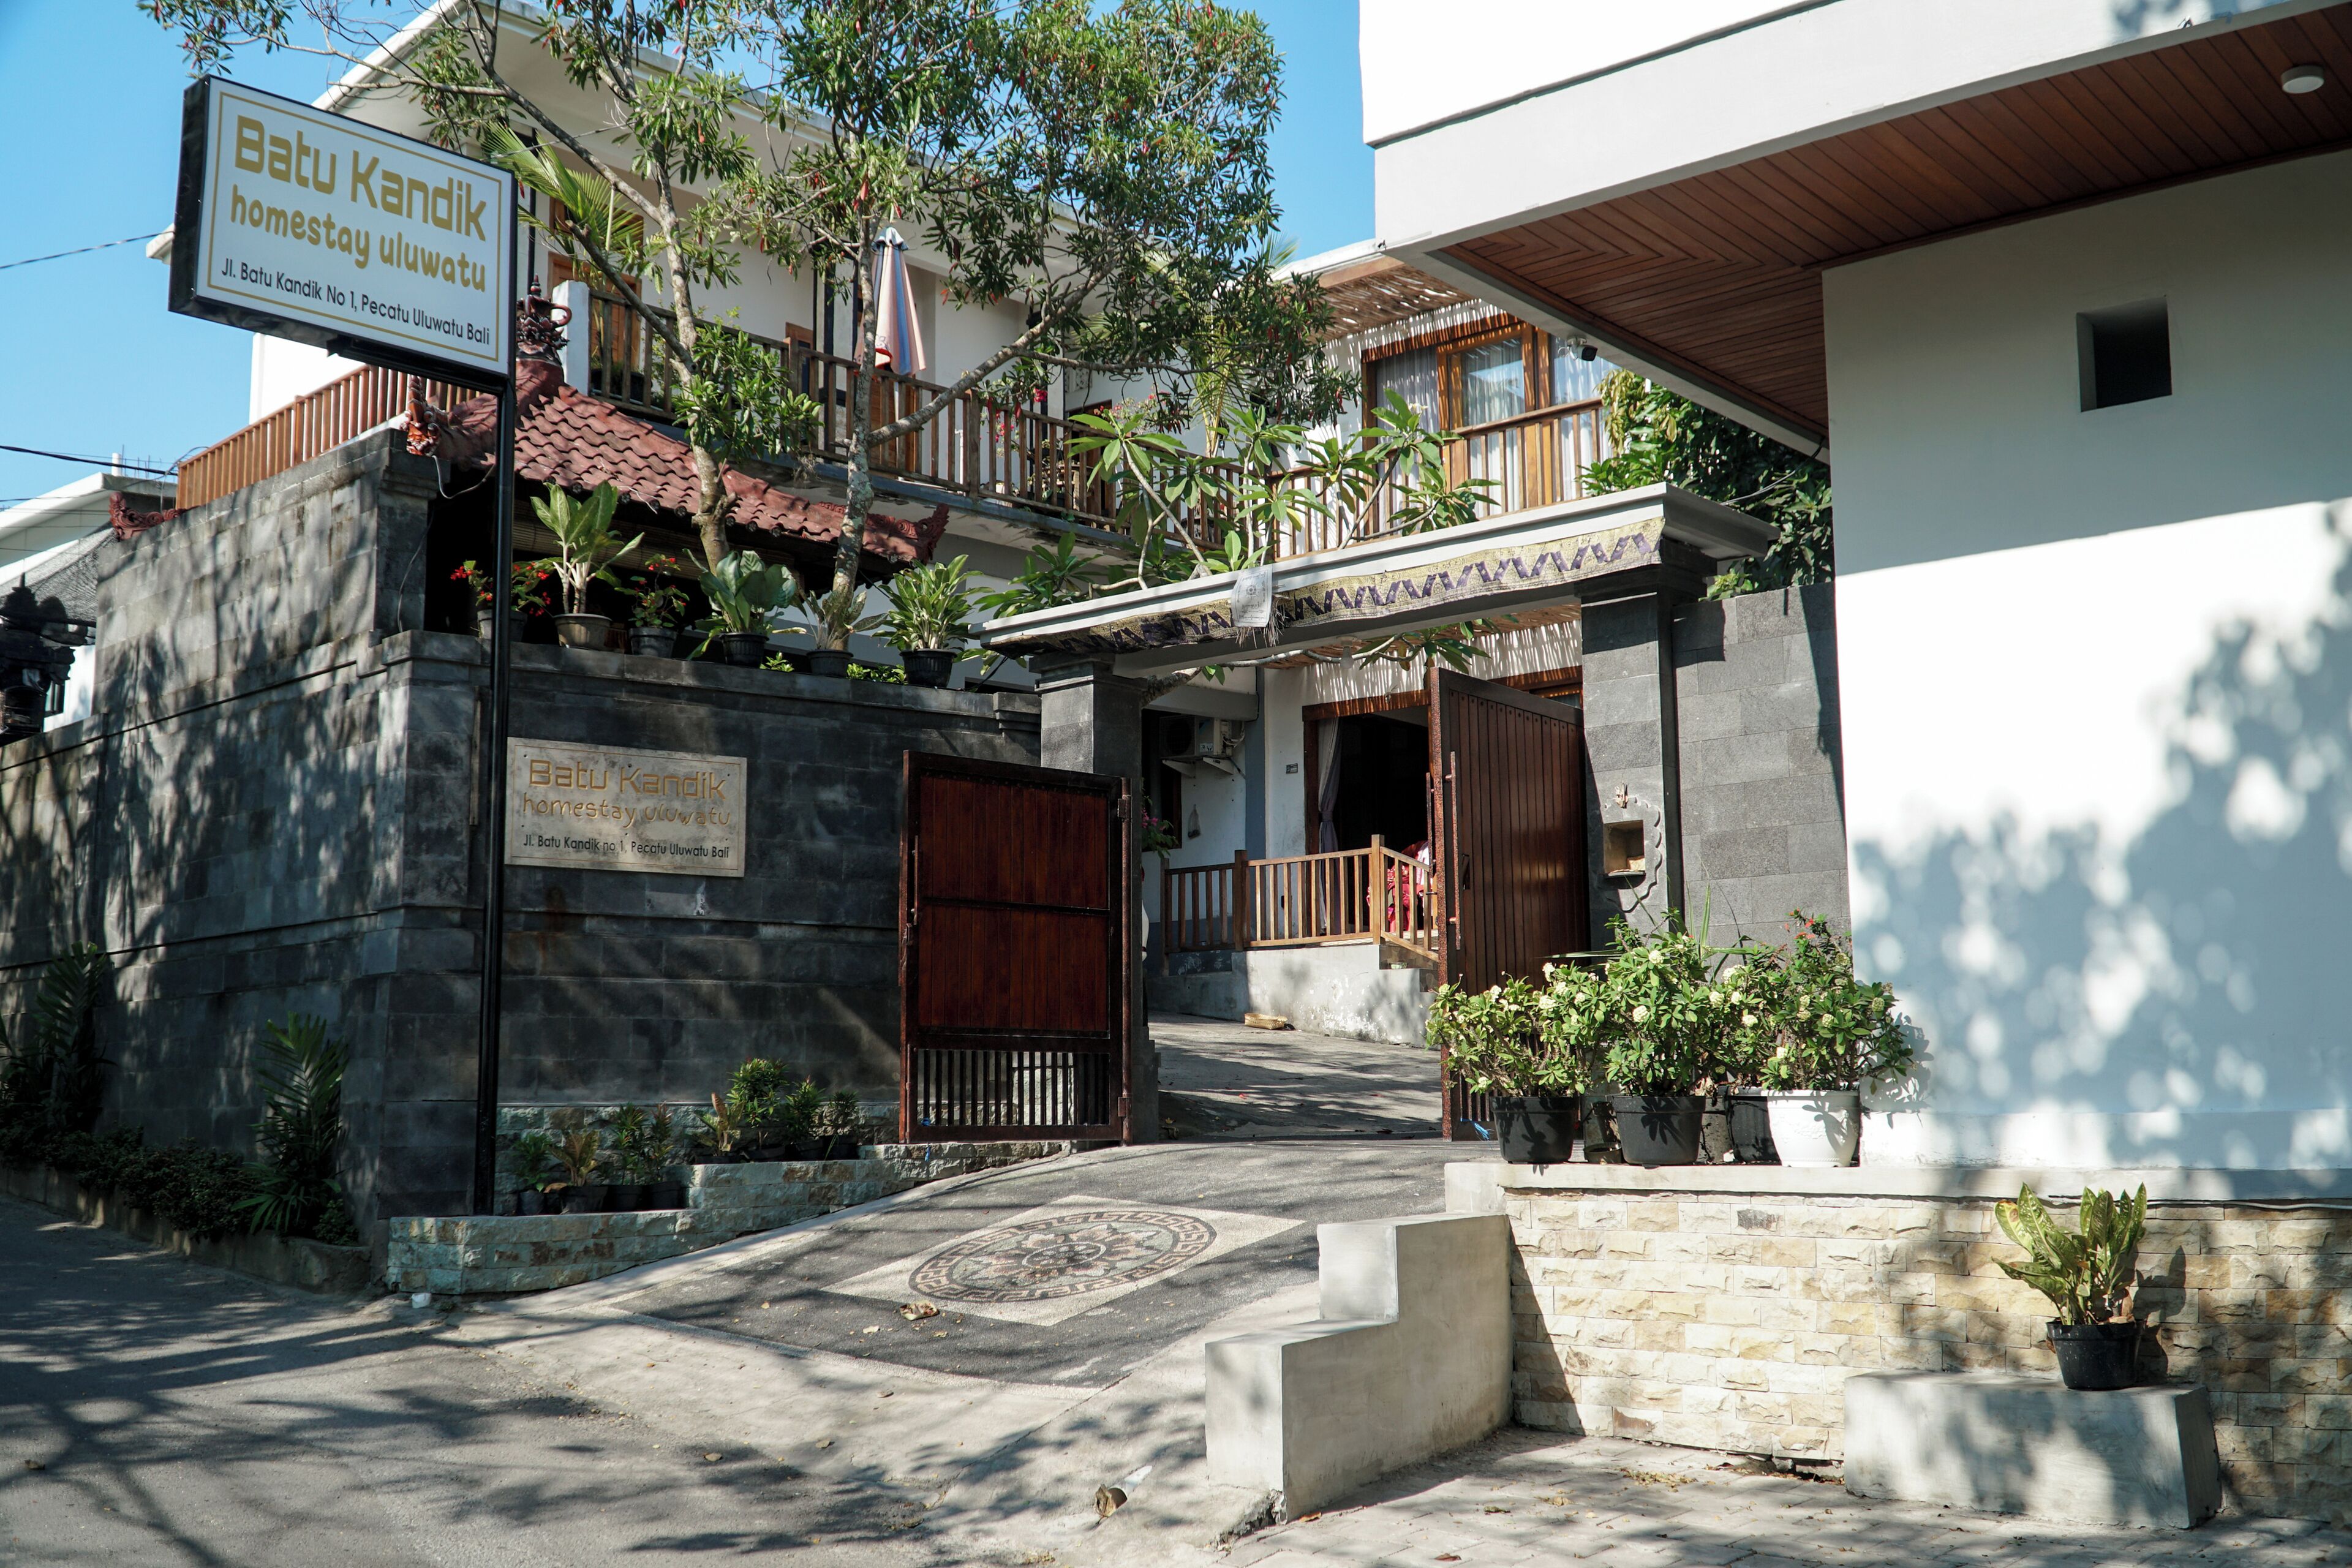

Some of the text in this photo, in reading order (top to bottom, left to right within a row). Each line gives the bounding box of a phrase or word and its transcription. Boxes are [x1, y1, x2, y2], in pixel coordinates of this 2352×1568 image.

[235, 115, 487, 242] Batu Kandik
[230, 184, 486, 292] homestay uluwatu
[222, 258, 489, 345] Jl. Batu Kandik No 1, Pecatu Uluwatu Bali
[523, 792, 731, 829] homestay uluwatu
[529, 759, 726, 800] Batu Kandik
[524, 834, 534, 846] Jl.
[538, 835, 560, 848] Batu
[564, 837, 600, 851] Kandik
[603, 842, 616, 851] no
[631, 841, 666, 854] Pecatu
[669, 843, 709, 857] Uluwatu
[712, 846, 729, 858] Bali
